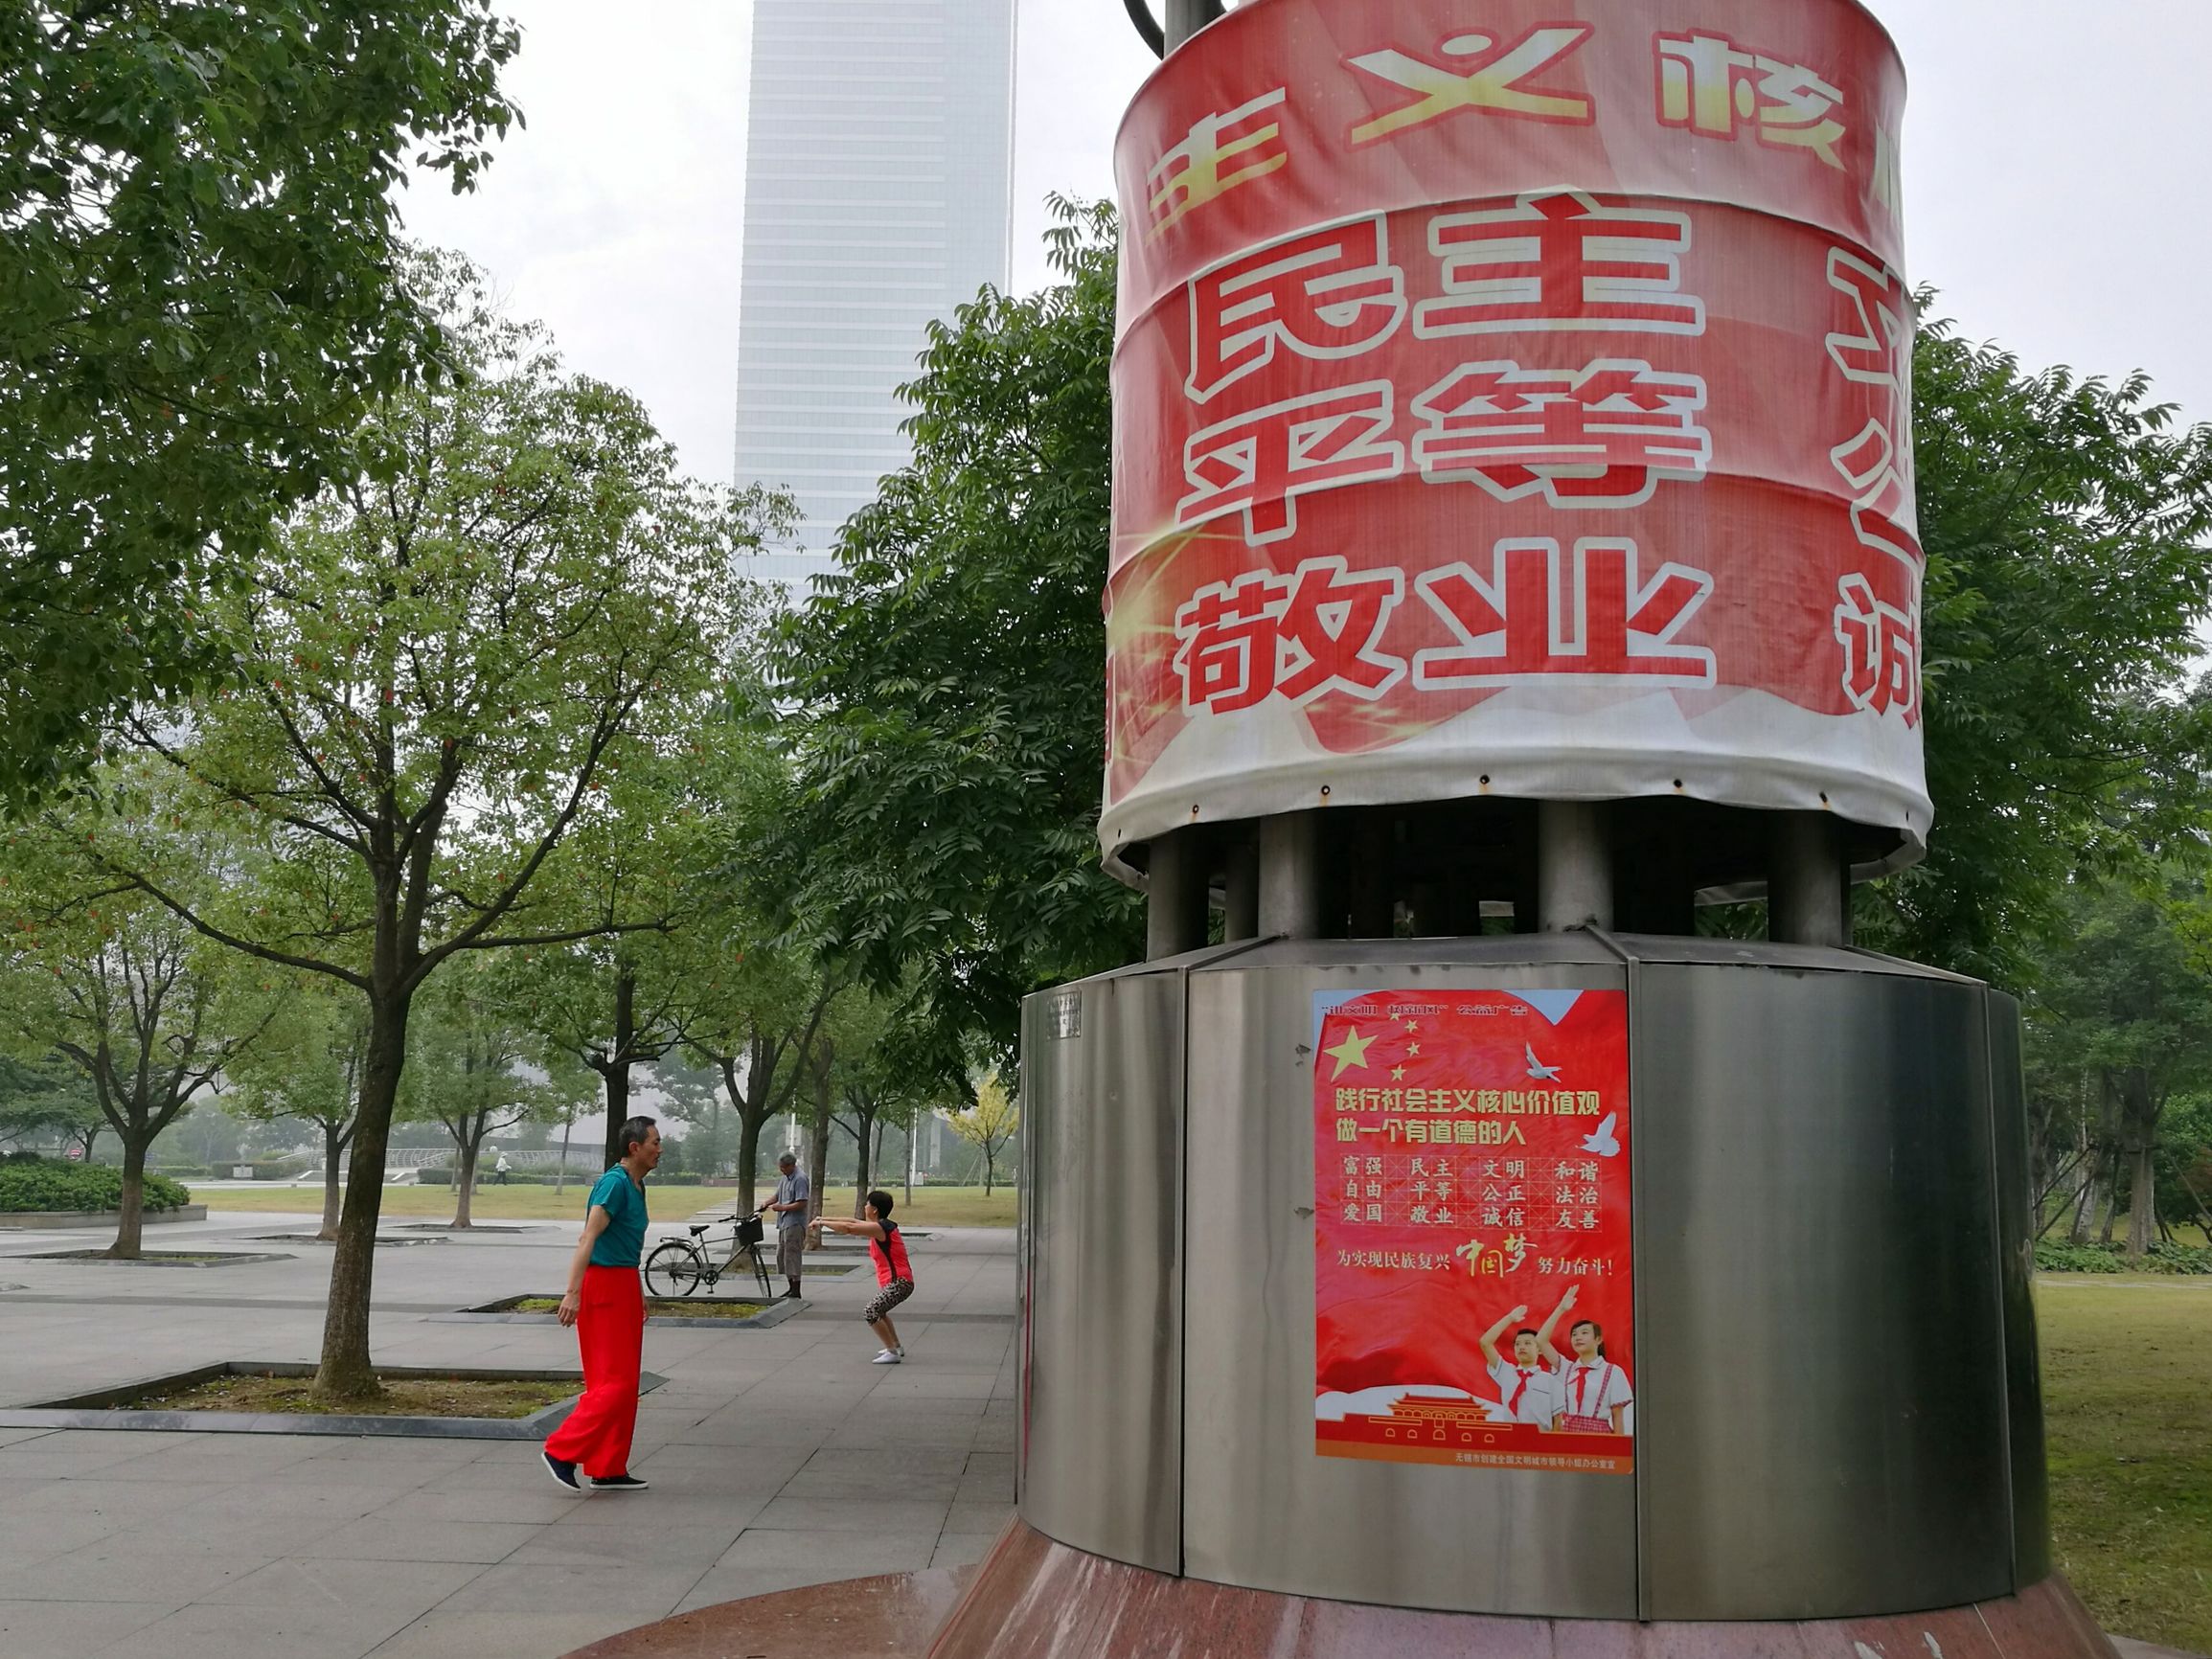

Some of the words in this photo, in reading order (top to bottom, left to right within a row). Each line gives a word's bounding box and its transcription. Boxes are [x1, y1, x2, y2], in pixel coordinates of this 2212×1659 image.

[1183, 183, 1706, 404] 民主
[1174, 359, 1712, 547] 平等
[1174, 536, 1718, 716] 敬业
[1335, 1088, 1601, 1116] 践行社会主义核心价值观
[1335, 1118, 1527, 1146] 做一个有道德的人
[1343, 1155, 1383, 1176] 富强
[1410, 1158, 1454, 1178] 民主
[1481, 1159, 1526, 1180] 文明
[1555, 1161, 1600, 1182] 和谐
[1344, 1179, 1382, 1198] 自由
[1410, 1181, 1453, 1201] 平等
[1481, 1183, 1527, 1203] 公正
[1555, 1185, 1600, 1205] 法治
[1344, 1203, 1382, 1223] 爱国
[1410, 1205, 1454, 1226] 敬业
[1481, 1206, 1527, 1228] 诚信
[1555, 1208, 1600, 1229] 友善
[1337, 1248, 1450, 1271] 为实现民族复兴
[1455, 1233, 1539, 1279] 中国梦
